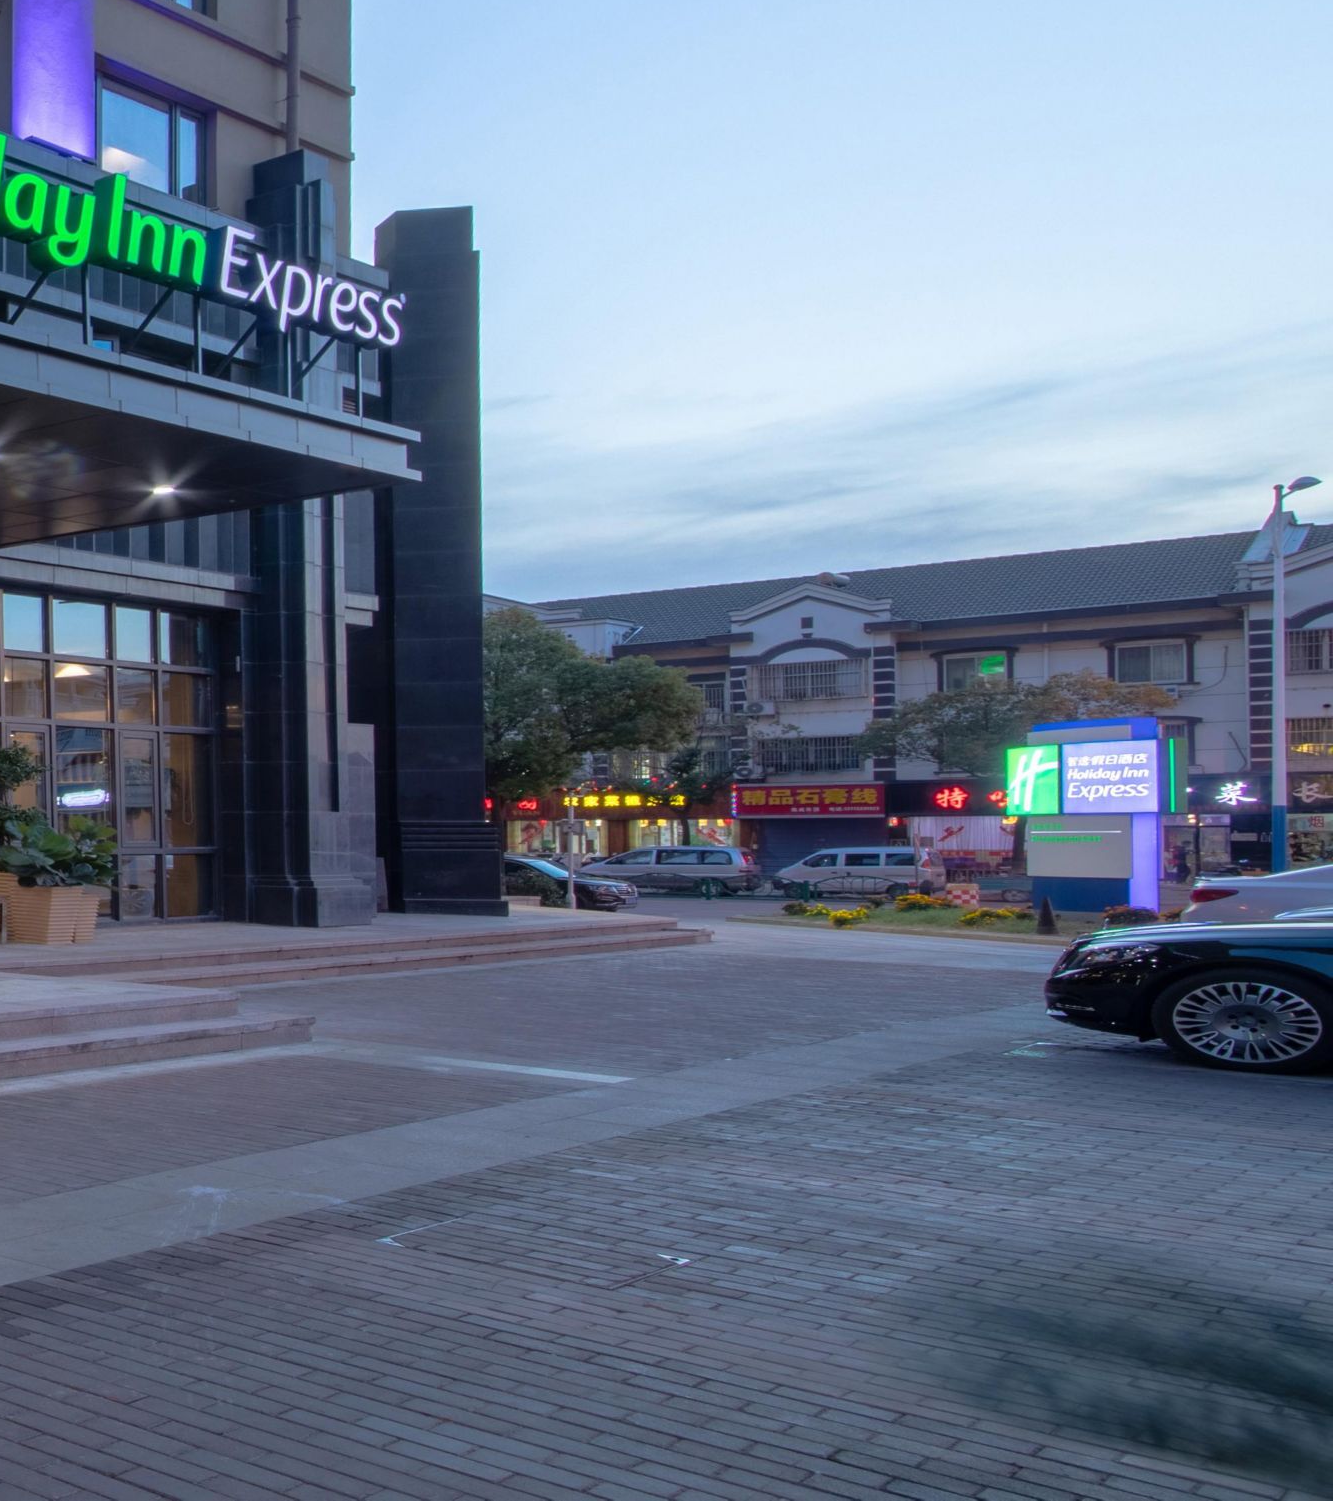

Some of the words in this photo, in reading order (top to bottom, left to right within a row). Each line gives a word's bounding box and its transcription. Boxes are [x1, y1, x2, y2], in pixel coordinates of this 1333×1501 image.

[107, 173, 209, 288] Inn
[219, 225, 405, 348] Express
[1067, 767, 1122, 782] Holiday
[1122, 766, 1150, 779] Inn
[741, 788, 878, 806] 精品石膏线
[1067, 782, 1150, 802] Express
